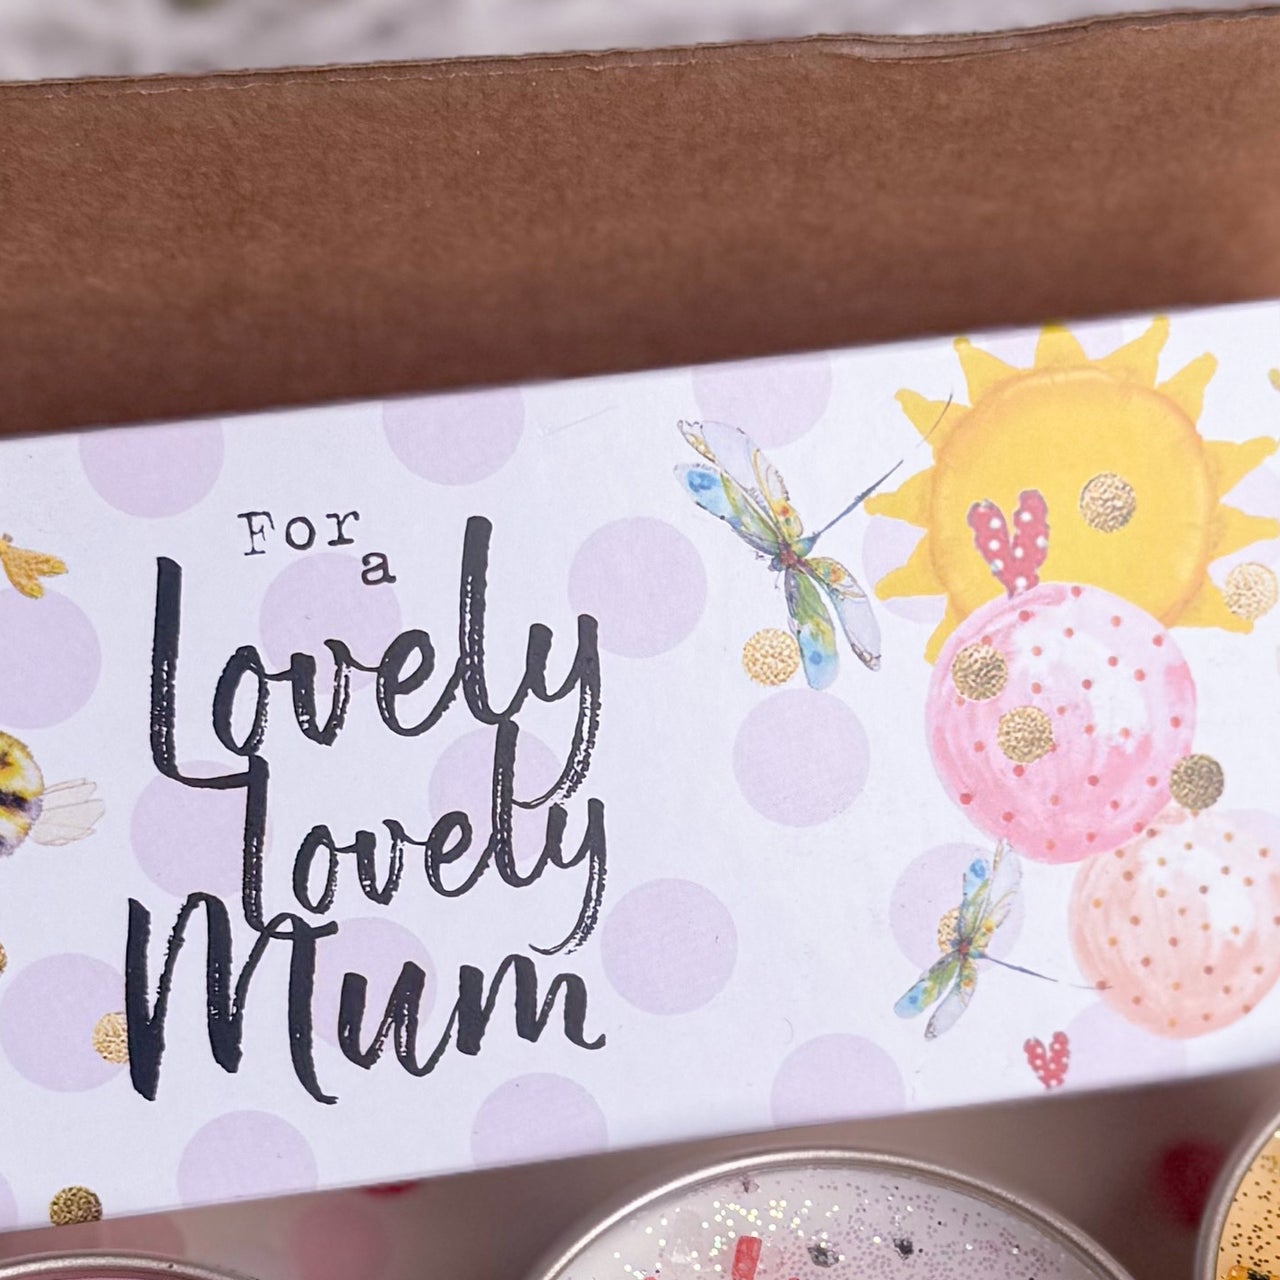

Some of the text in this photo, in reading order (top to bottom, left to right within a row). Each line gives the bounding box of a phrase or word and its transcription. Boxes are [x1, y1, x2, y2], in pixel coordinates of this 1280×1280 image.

[237, 510, 360, 557] For
[361, 551, 397, 586] a
[150, 516, 601, 810] Lovely
[125, 891, 607, 1105] Mum
